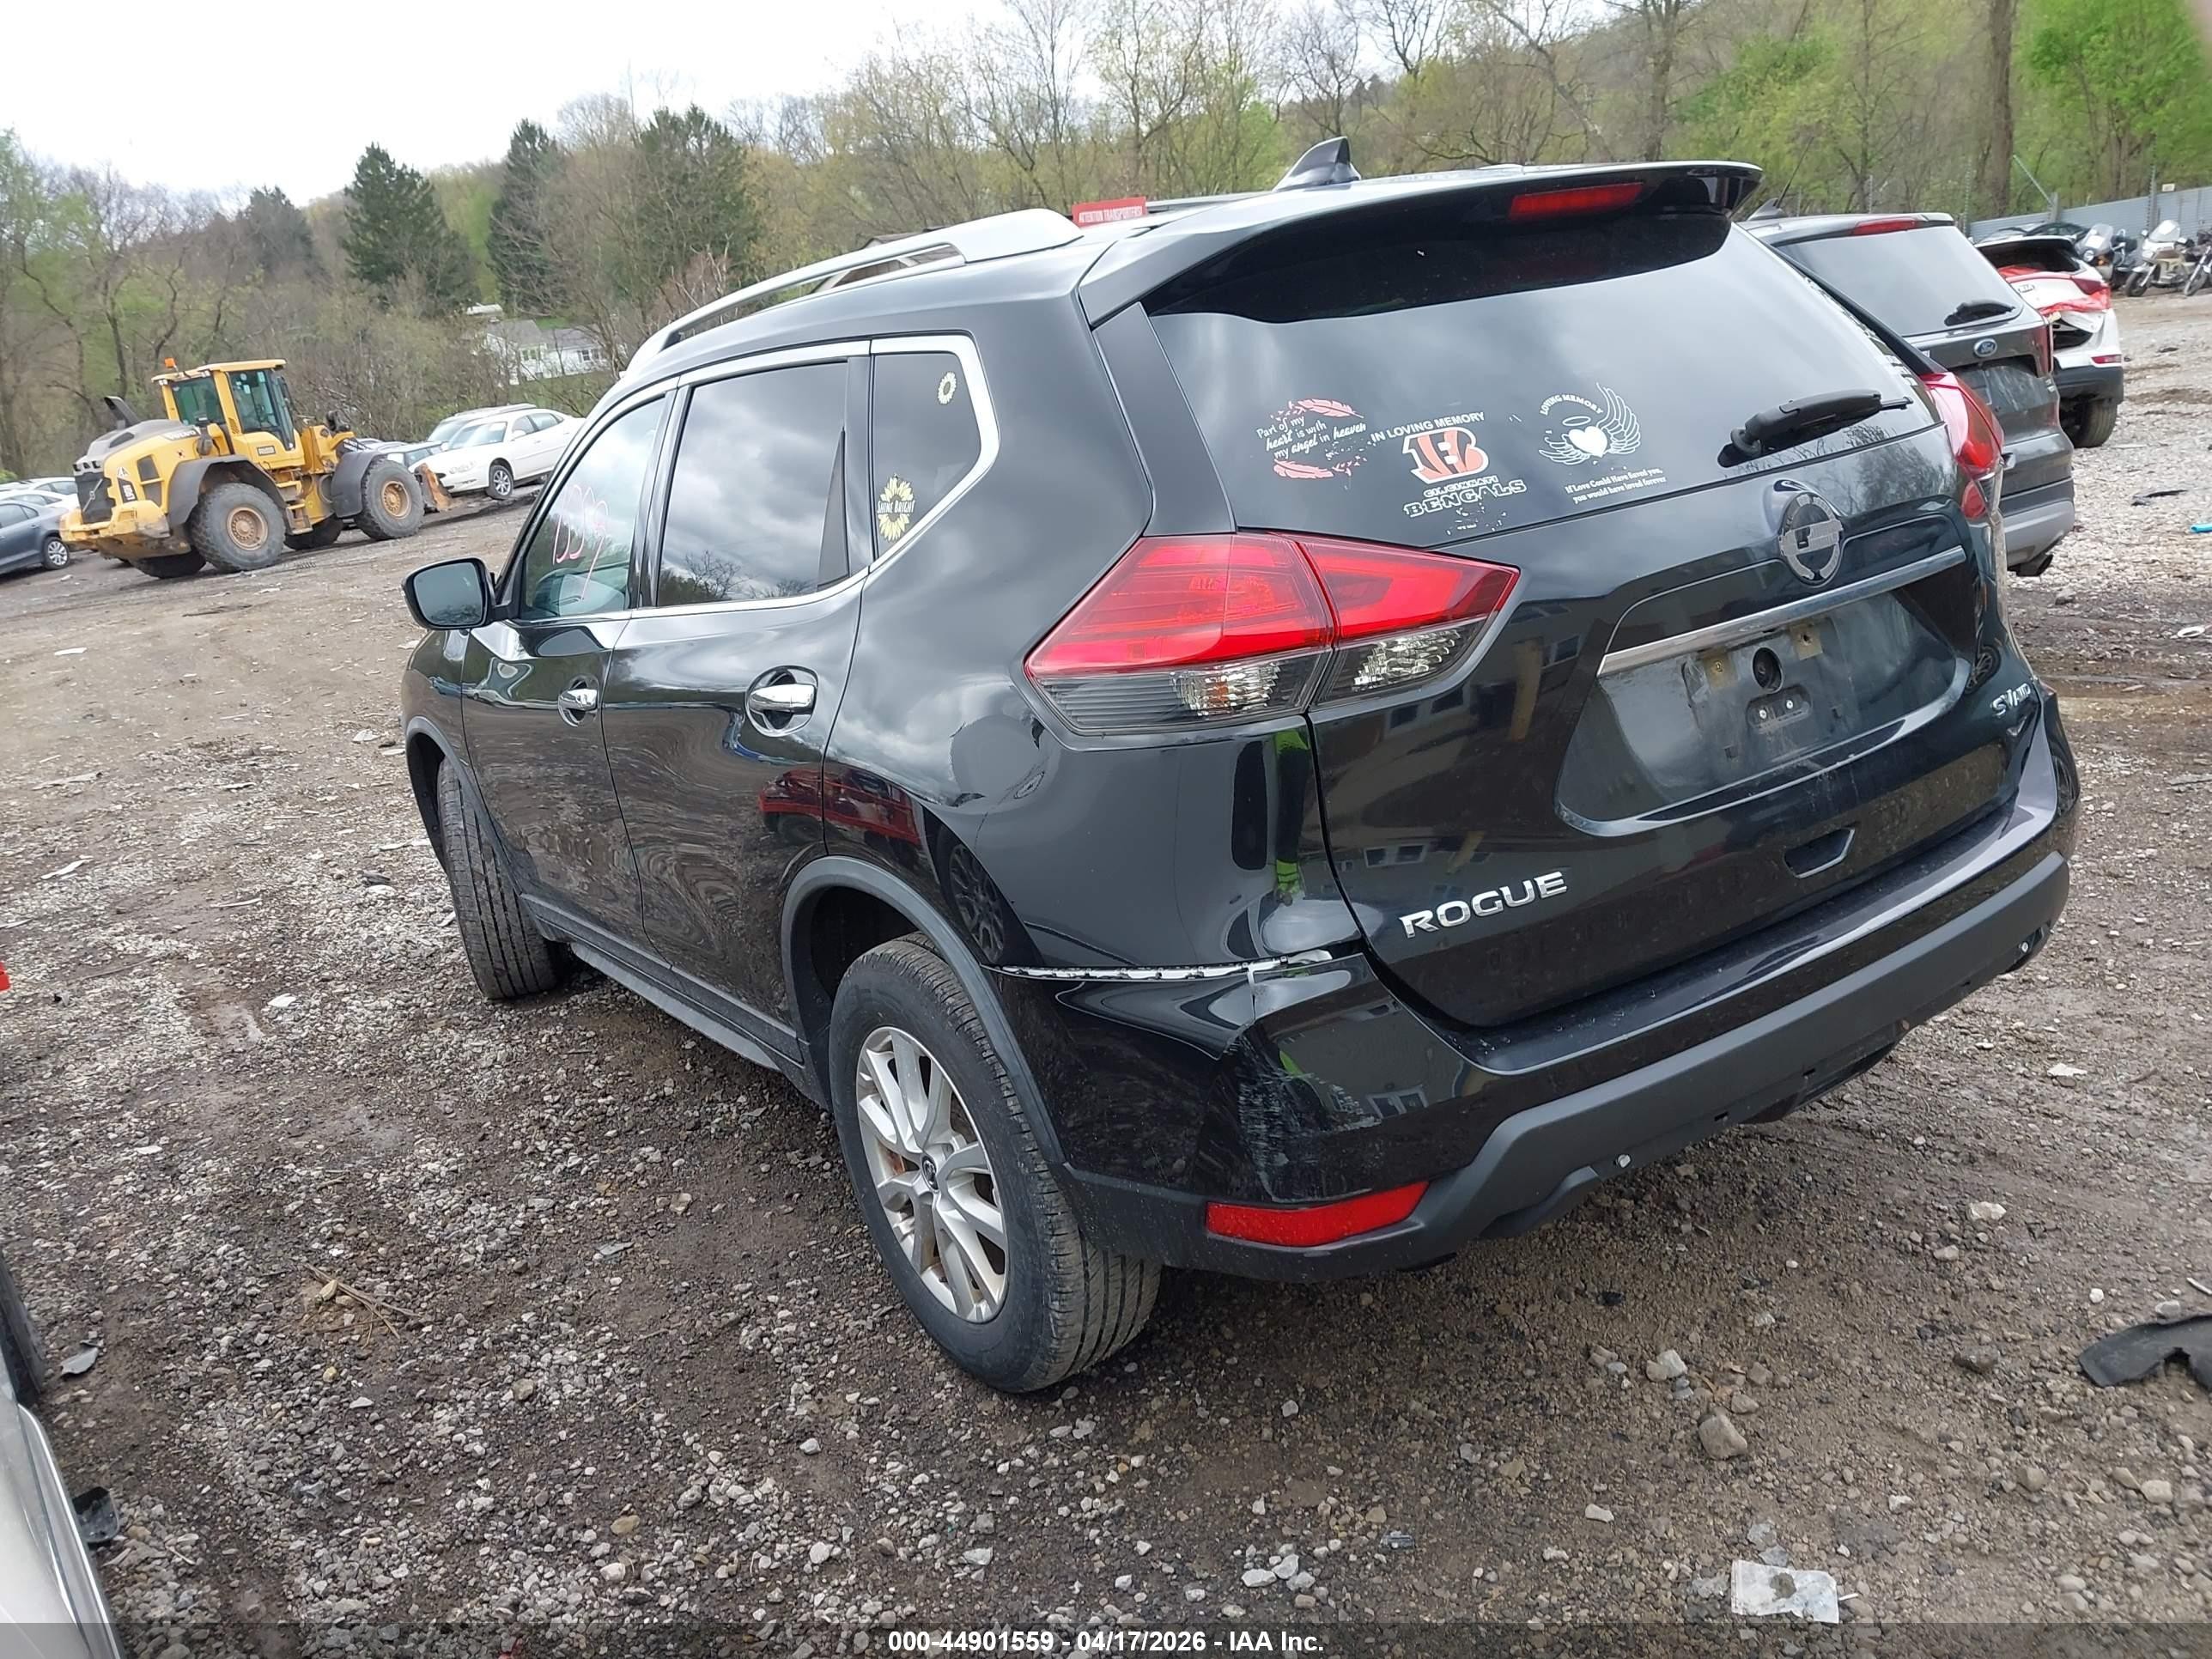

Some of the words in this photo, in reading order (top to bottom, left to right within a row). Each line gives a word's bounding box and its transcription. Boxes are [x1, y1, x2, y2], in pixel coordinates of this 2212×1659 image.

[1540, 394, 1562, 416] LOVING
[1562, 394, 1603, 414] MEMORY
[1256, 424, 1277, 439] Part
[1279, 417, 1288, 432] of
[1291, 416, 1304, 427] my
[1266, 429, 1293, 451] heart
[1296, 428, 1305, 439] is
[1306, 420, 1327, 435] with
[1274, 448, 1289, 459] my
[1291, 433, 1318, 454] angel
[1320, 433, 1330, 443] in
[1334, 422, 1366, 440] heaven
[1370, 432, 1386, 443] IN
[1387, 420, 1433, 438] LOVING
[1434, 412, 1485, 428] MEMORY
[1403, 479, 1528, 518] BENGALS
[1565, 484, 1573, 494] If
[1573, 483, 1590, 492] Love
[1589, 477, 1612, 488] Could
[1611, 473, 1629, 483] Have
[1573, 495, 1588, 505] you
[1588, 488, 1608, 499] would
[1607, 484, 1626, 494] have
[1625, 479, 1644, 490] loved
[1643, 476, 1667, 487] forever
[878, 500, 893, 514] SHINE
[894, 499, 915, 514] BRIGHT
[1399, 871, 1568, 939] ROGUE
